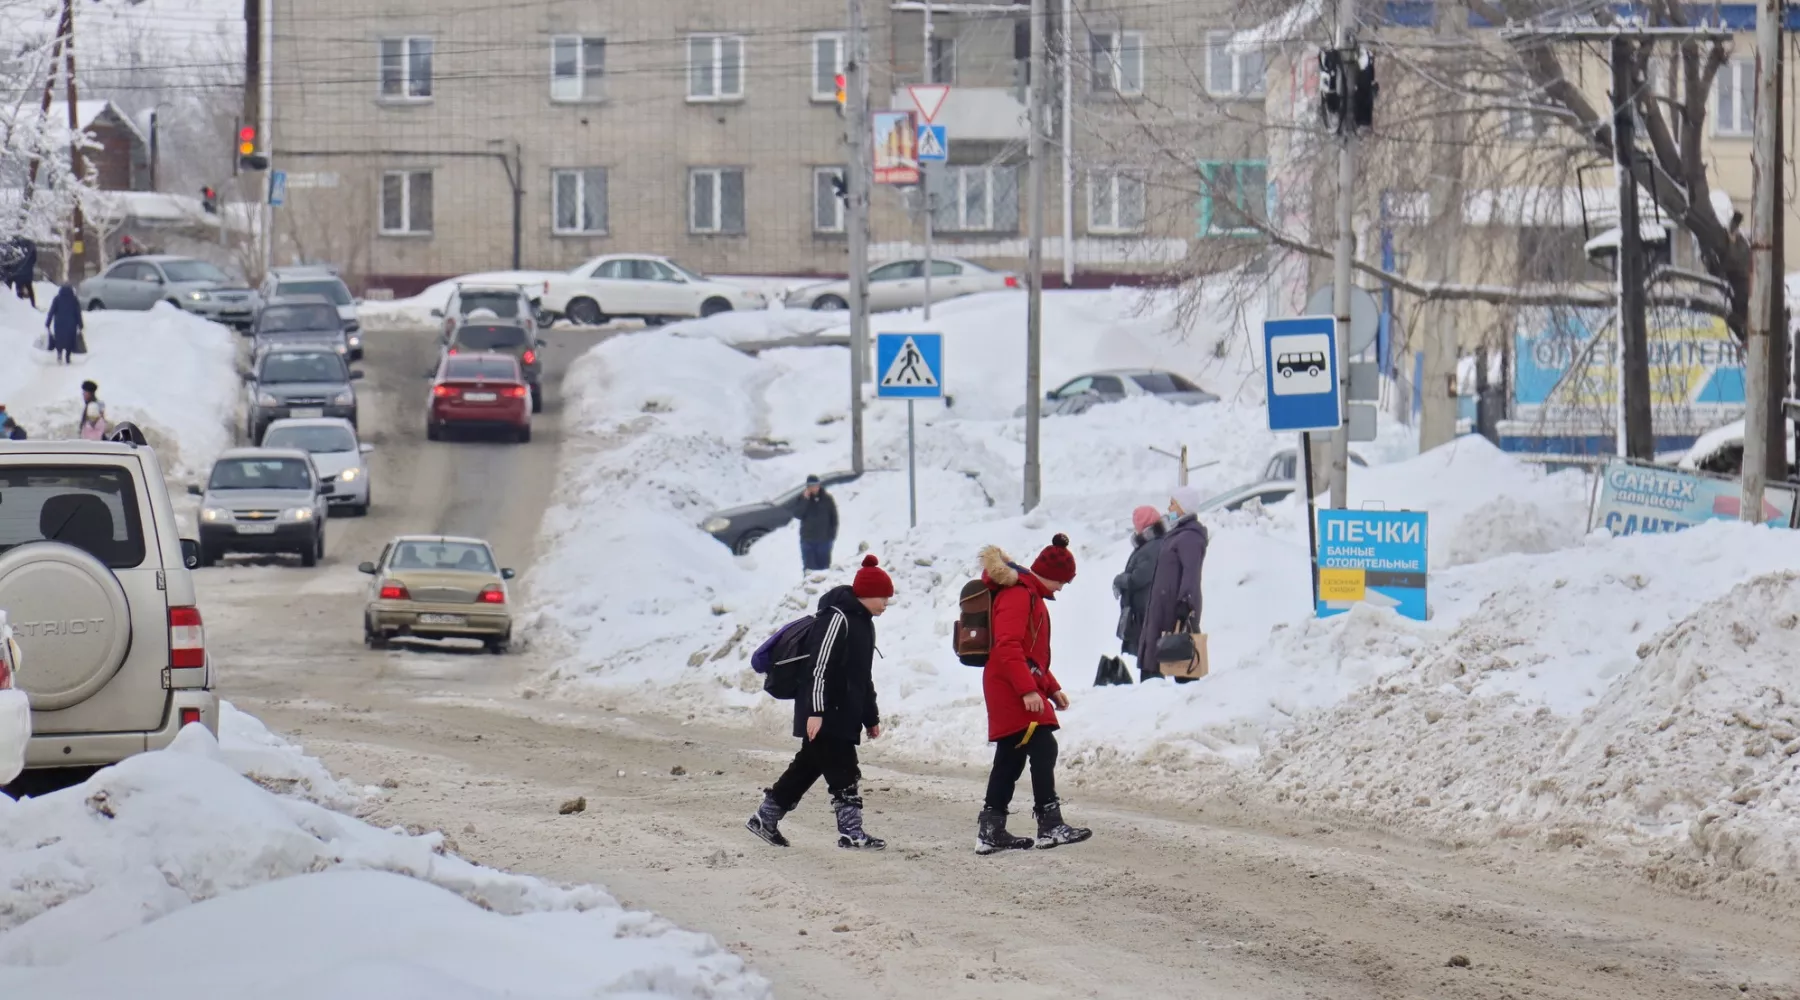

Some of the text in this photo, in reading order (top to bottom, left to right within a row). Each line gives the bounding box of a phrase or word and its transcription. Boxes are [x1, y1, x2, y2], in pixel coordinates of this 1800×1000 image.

[1611, 469, 1695, 500] САНТЕХ
[1327, 519, 1420, 544] ПЕЧКИ
[1327, 546, 1376, 557] БАННЫЕ
[1326, 558, 1419, 570] ОТОПИТЕЛЬНЫЕ
[12, 618, 106, 637] ATRIOT
